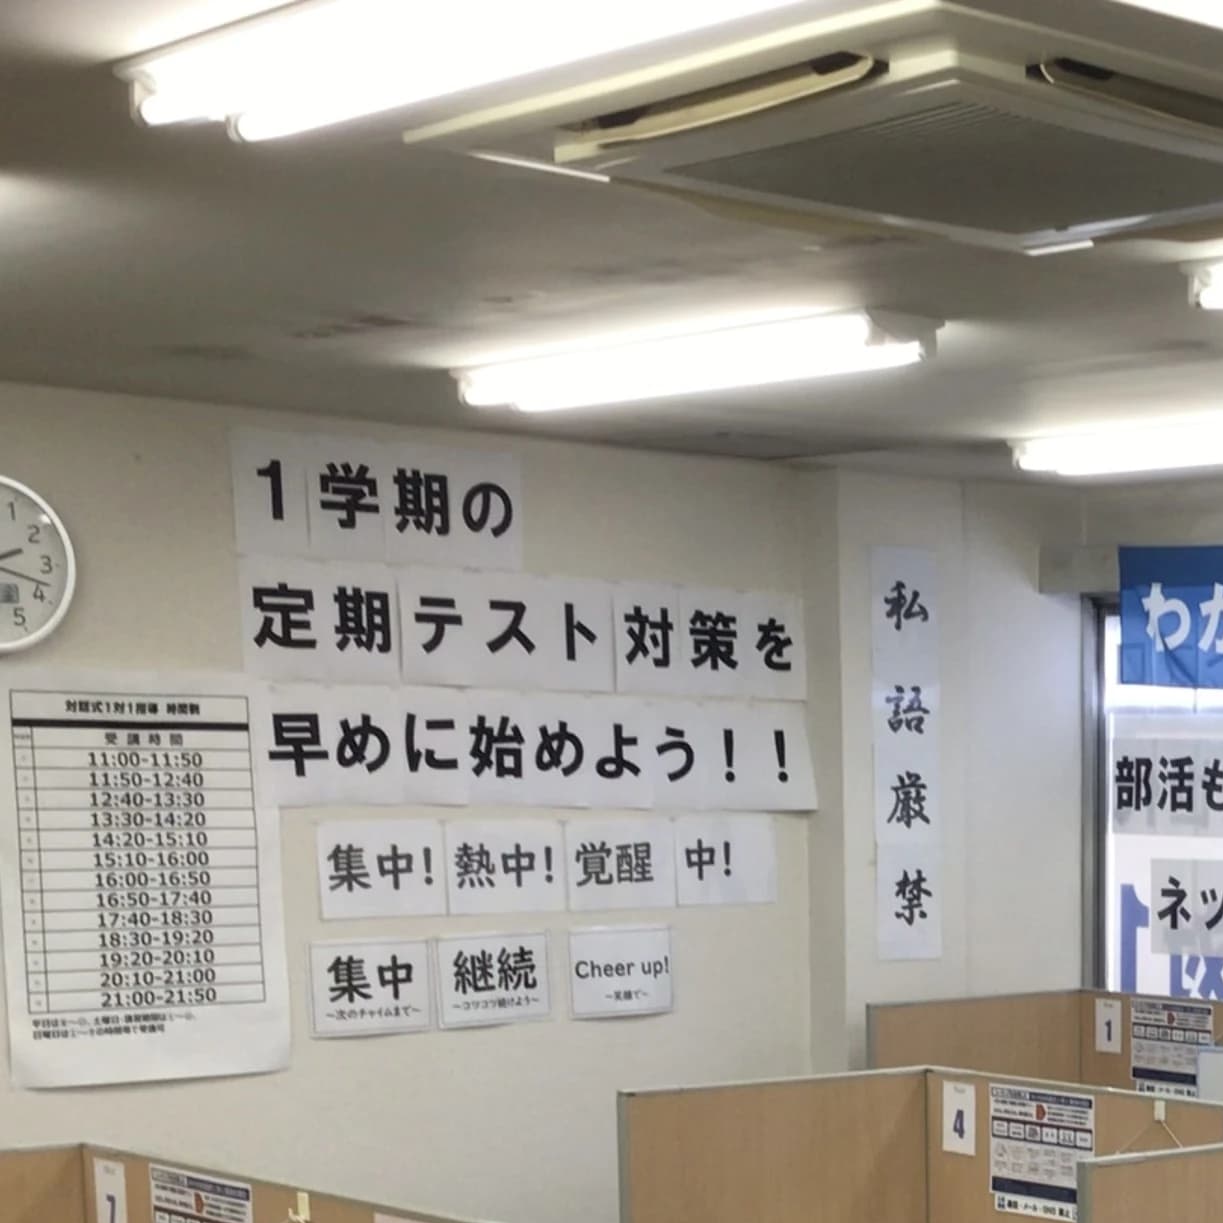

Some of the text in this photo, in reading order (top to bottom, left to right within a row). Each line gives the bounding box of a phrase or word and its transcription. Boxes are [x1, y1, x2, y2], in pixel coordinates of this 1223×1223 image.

[256, 459, 513, 538] 1学期の
[8, 501, 16, 521] 1
[27, 525, 41, 544] 2
[40, 555, 53, 575] 3
[33, 584, 46, 603] 4
[13, 607, 26, 626] 5
[251, 583, 794, 671] 定期テスト対策を
[88, 751, 203, 768] 11:00-11:50
[89, 772, 204, 788] 11:50-12:40
[89, 792, 205, 808] 12:40-13:30
[91, 811, 206, 828] 13:30-14:20
[92, 831, 208, 848] 14:20-15:10
[93, 851, 209, 868] 15:10-16:00
[95, 870, 211, 888] 16:00-16:50
[96, 890, 212, 908] 16:50-17:40
[97, 909, 213, 928] 17:40-18:30
[98, 929, 214, 948] 18:30-19:20
[99, 949, 215, 967] 19:20-20:10
[100, 968, 216, 987] 20:10-21:00
[452, 946, 538, 994] 継続
[575, 957, 670, 980] Cheer up!
[326, 954, 414, 1003] 集中
[101, 988, 217, 1008] 21:00-21:50
[1103, 1020, 1112, 1041] 1
[953, 1109, 965, 1139] 4
